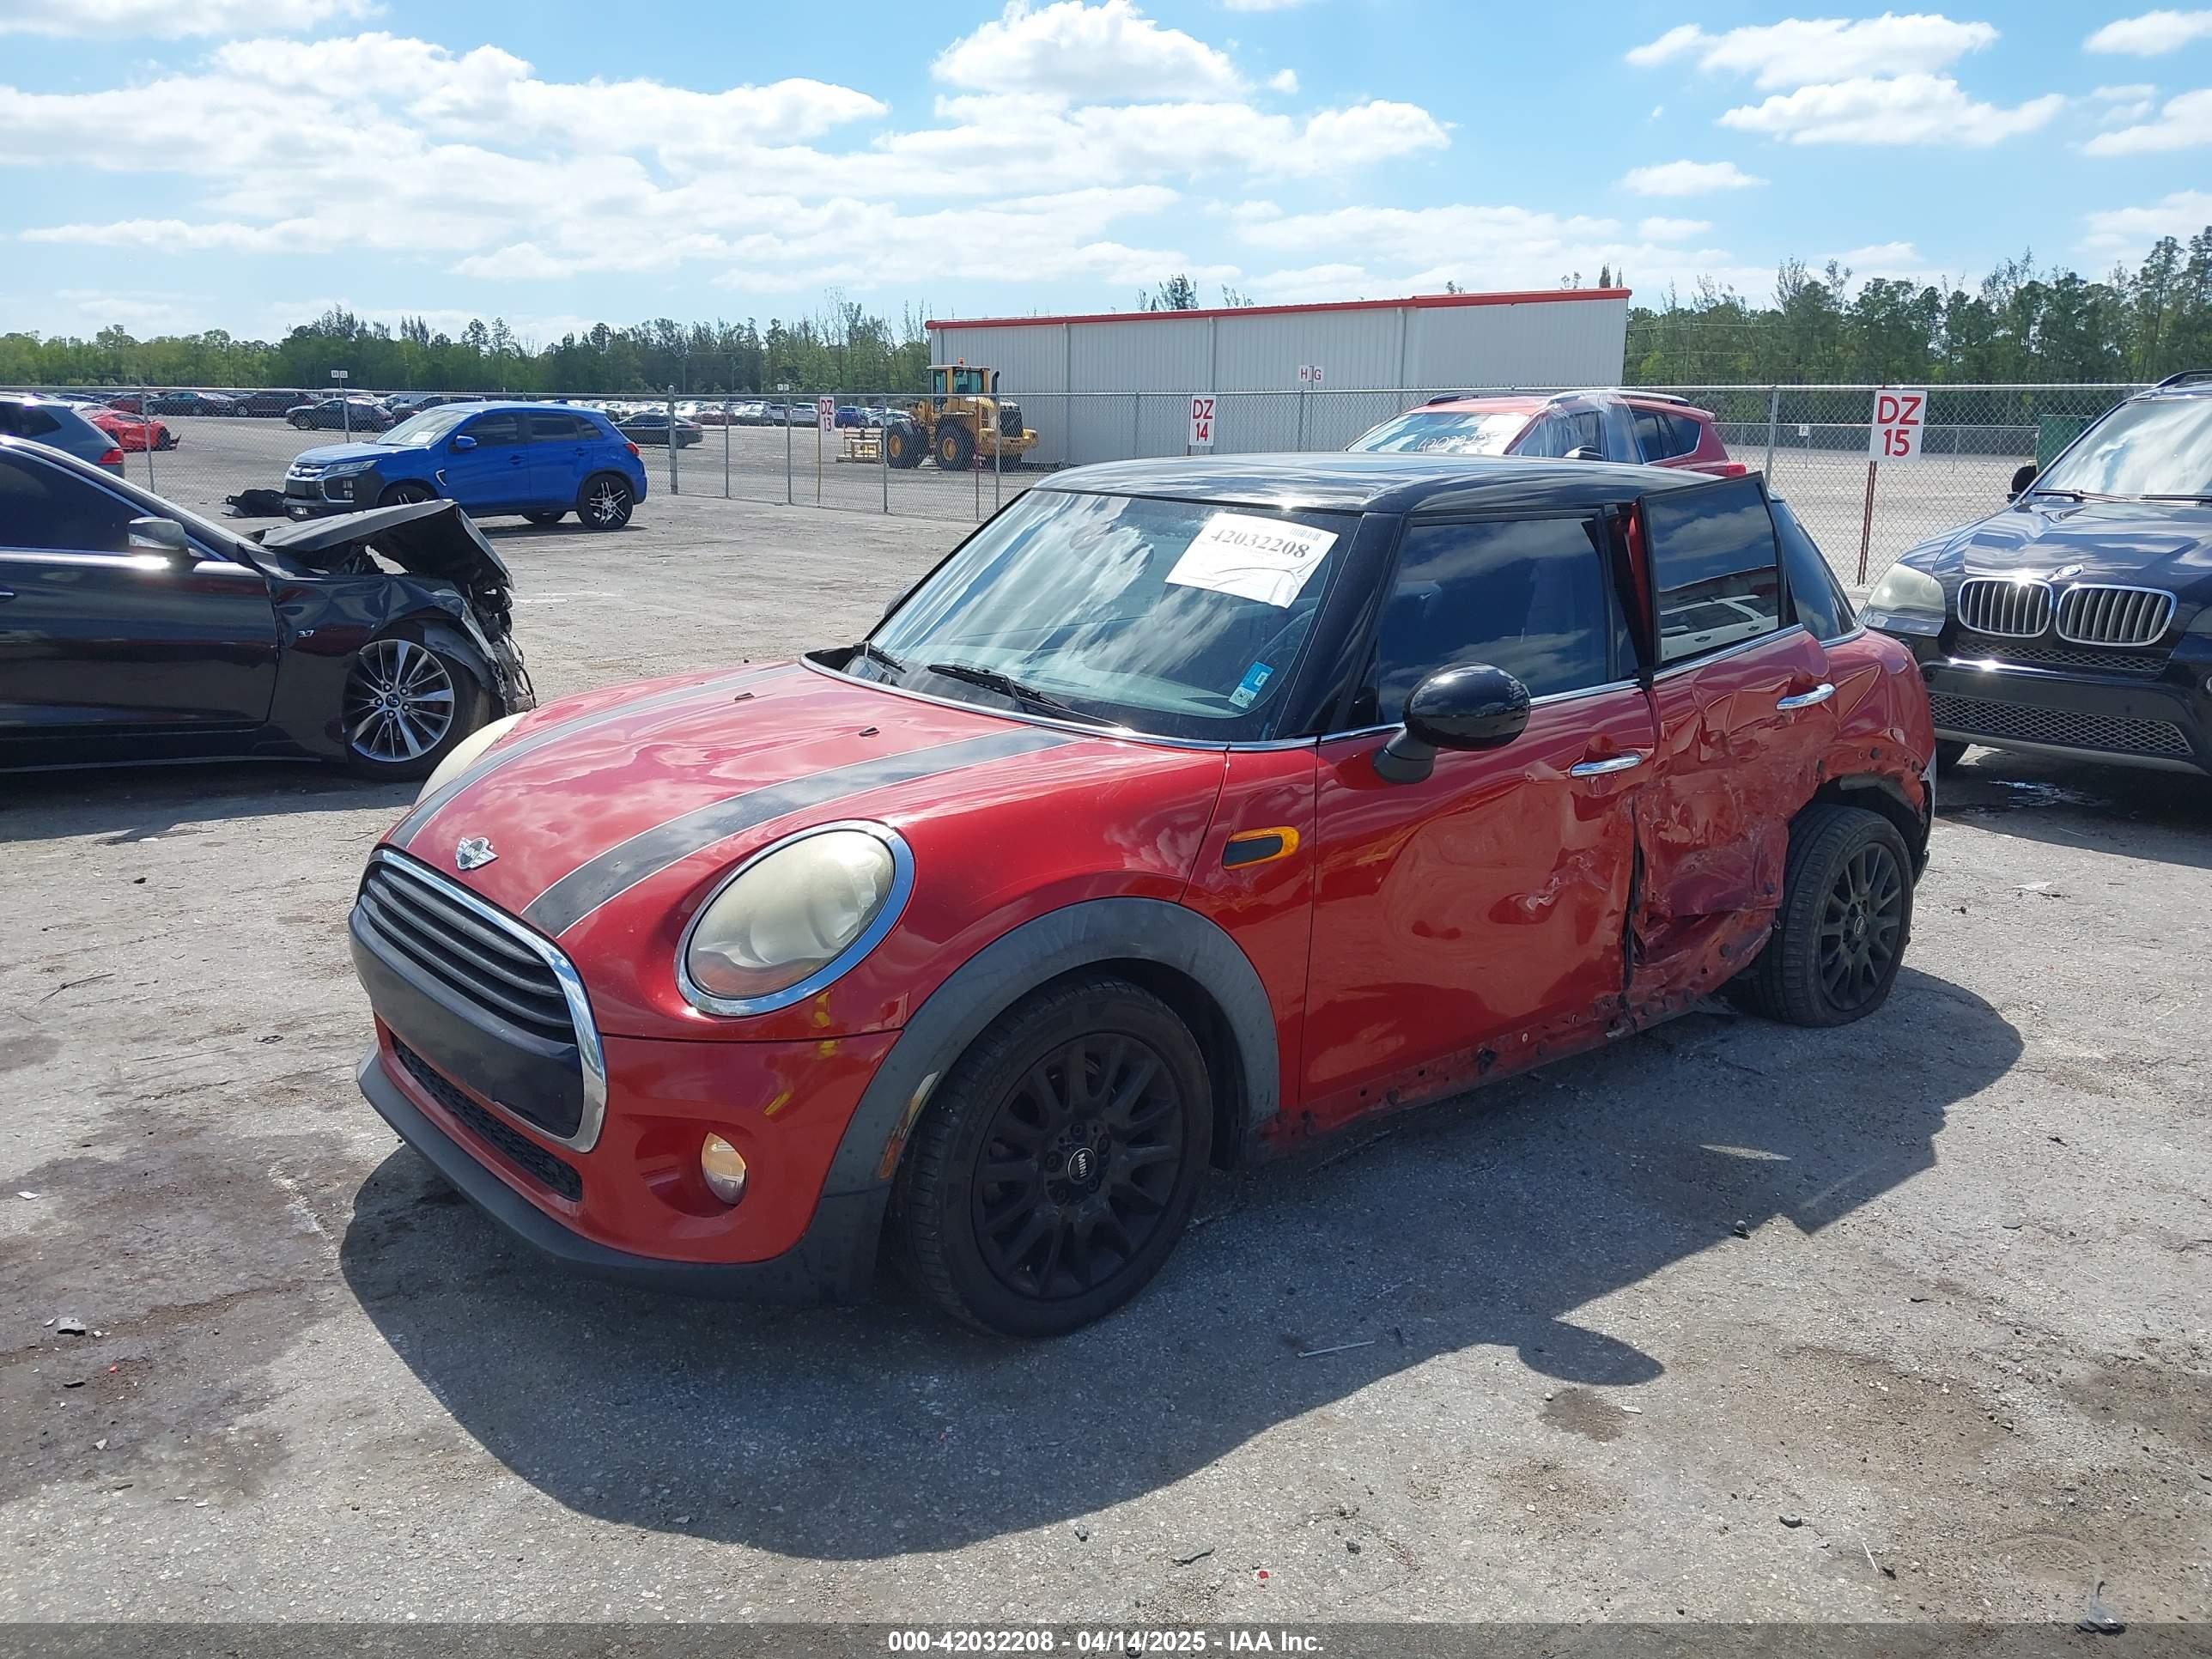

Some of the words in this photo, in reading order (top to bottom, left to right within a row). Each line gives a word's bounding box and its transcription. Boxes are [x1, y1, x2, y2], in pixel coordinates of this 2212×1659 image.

[1300, 368, 1308, 380] H
[1314, 369, 1322, 380] G
[821, 399, 834, 416] DZ
[1193, 399, 1214, 419] DZ
[1877, 396, 1922, 425] DZ
[823, 417, 832, 432] 13
[1196, 422, 1208, 441] 14
[1883, 428, 1911, 457] 15
[1210, 528, 1310, 558] 42032208
[1078, 1152, 1088, 1178] MINI
